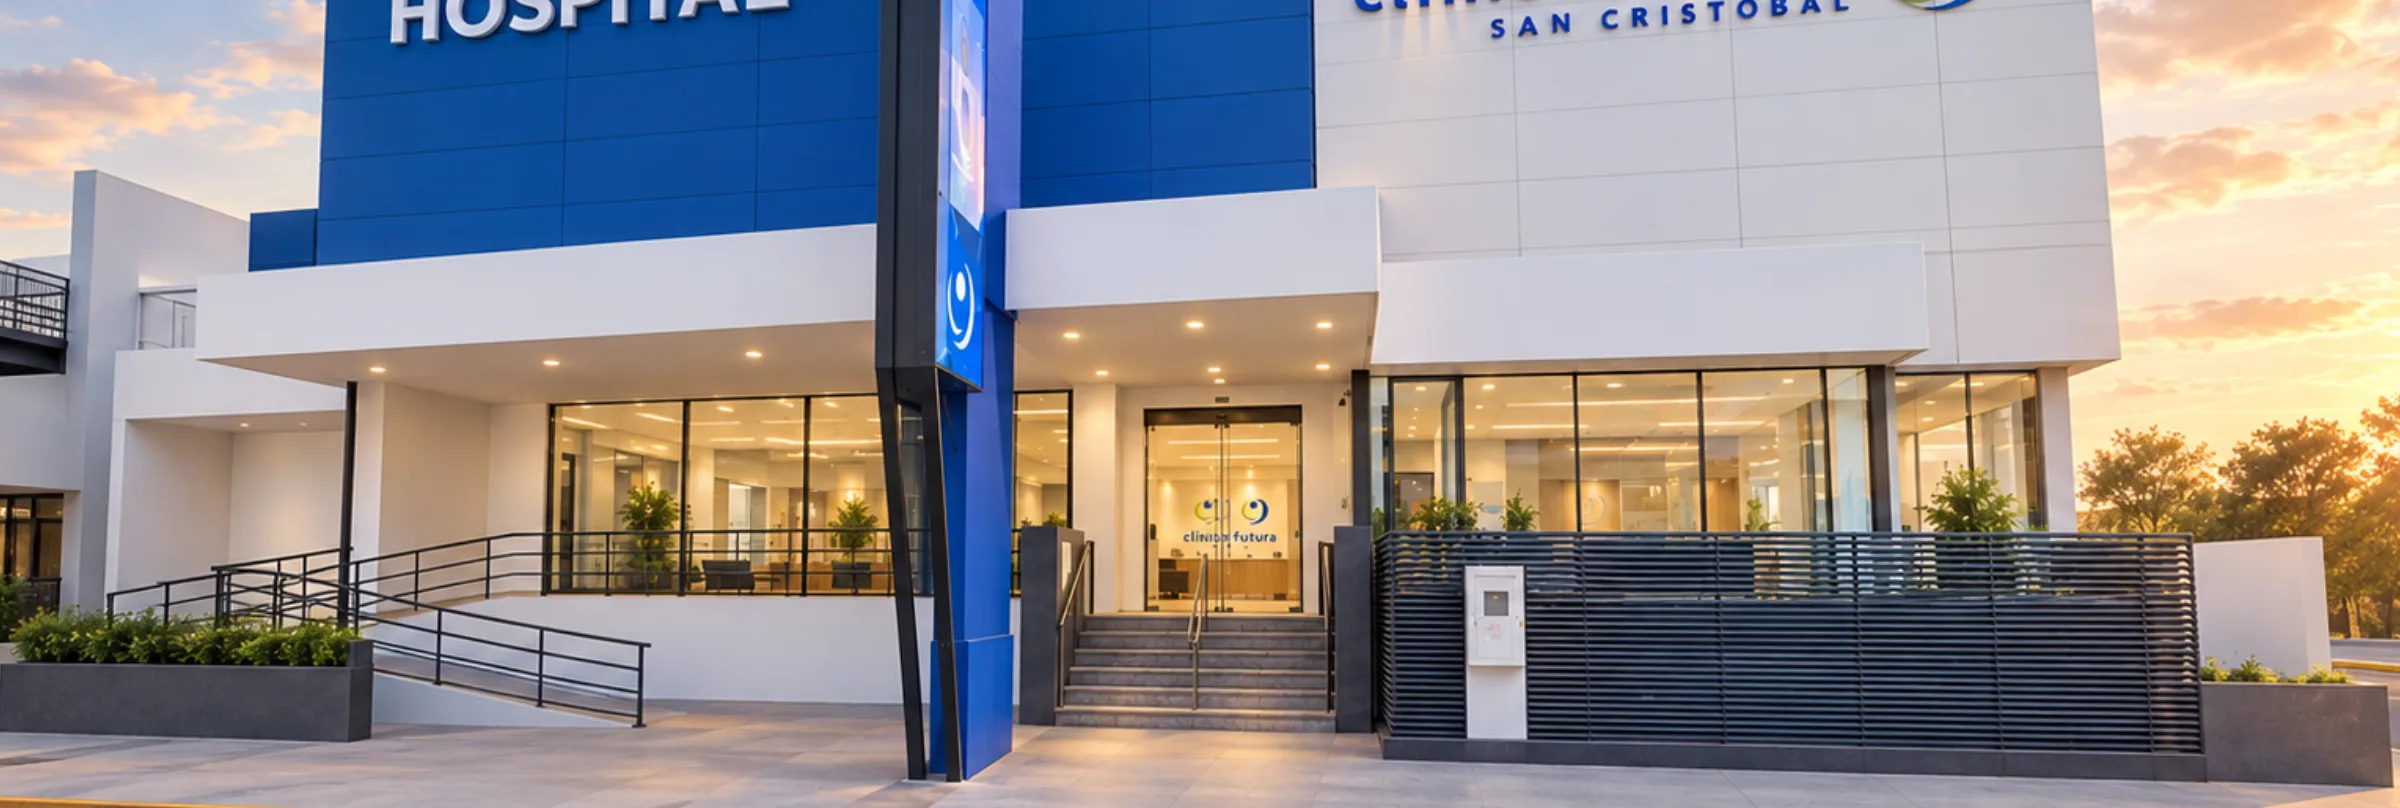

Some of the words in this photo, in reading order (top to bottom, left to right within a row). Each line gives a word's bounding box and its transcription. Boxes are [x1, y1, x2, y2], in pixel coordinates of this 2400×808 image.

[390, 0, 790, 44] HOSP
[1490, 13, 1570, 39] SAN
[1601, 0, 1850, 30] CRISTOBAL
[1233, 530, 1277, 543] futura
